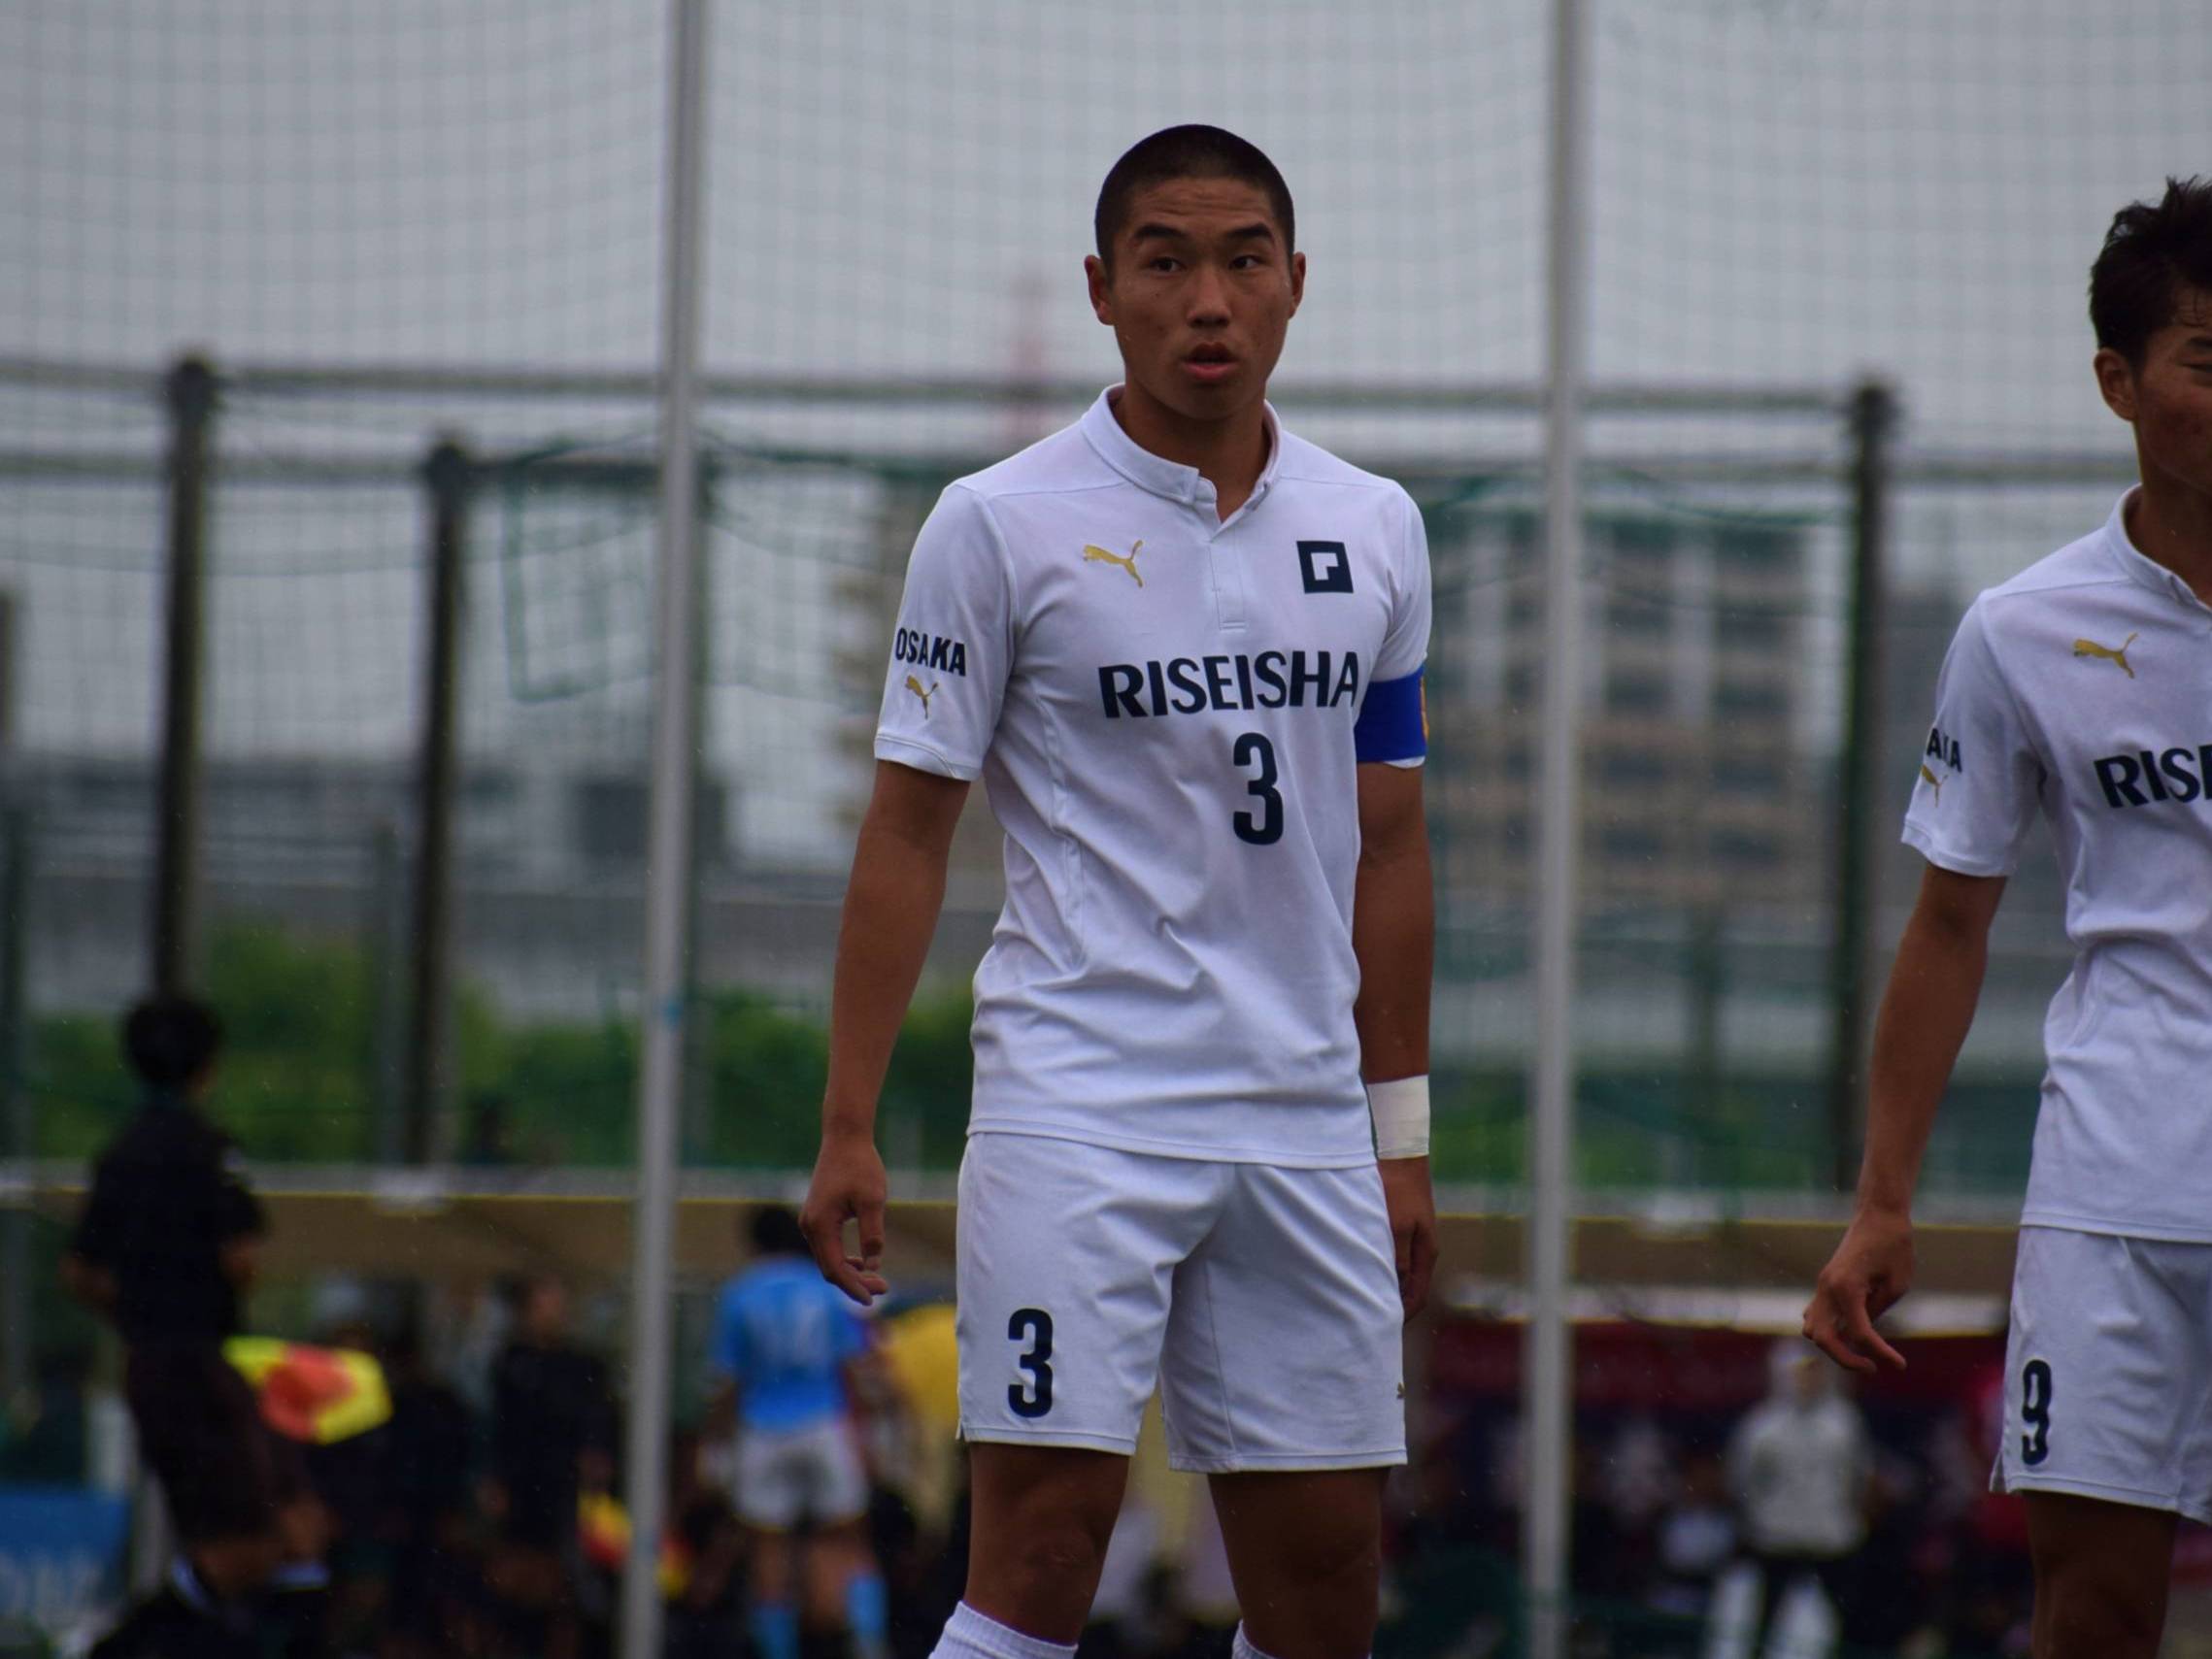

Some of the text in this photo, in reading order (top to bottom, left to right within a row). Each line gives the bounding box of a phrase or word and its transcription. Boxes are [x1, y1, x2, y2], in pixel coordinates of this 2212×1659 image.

[895, 627, 967, 678] OSAKA
[1097, 650, 1359, 719] RISEISHA
[1232, 732, 1285, 846] 3
[1007, 1308, 1054, 1419] 3
[2022, 1359, 2053, 1466] 9
